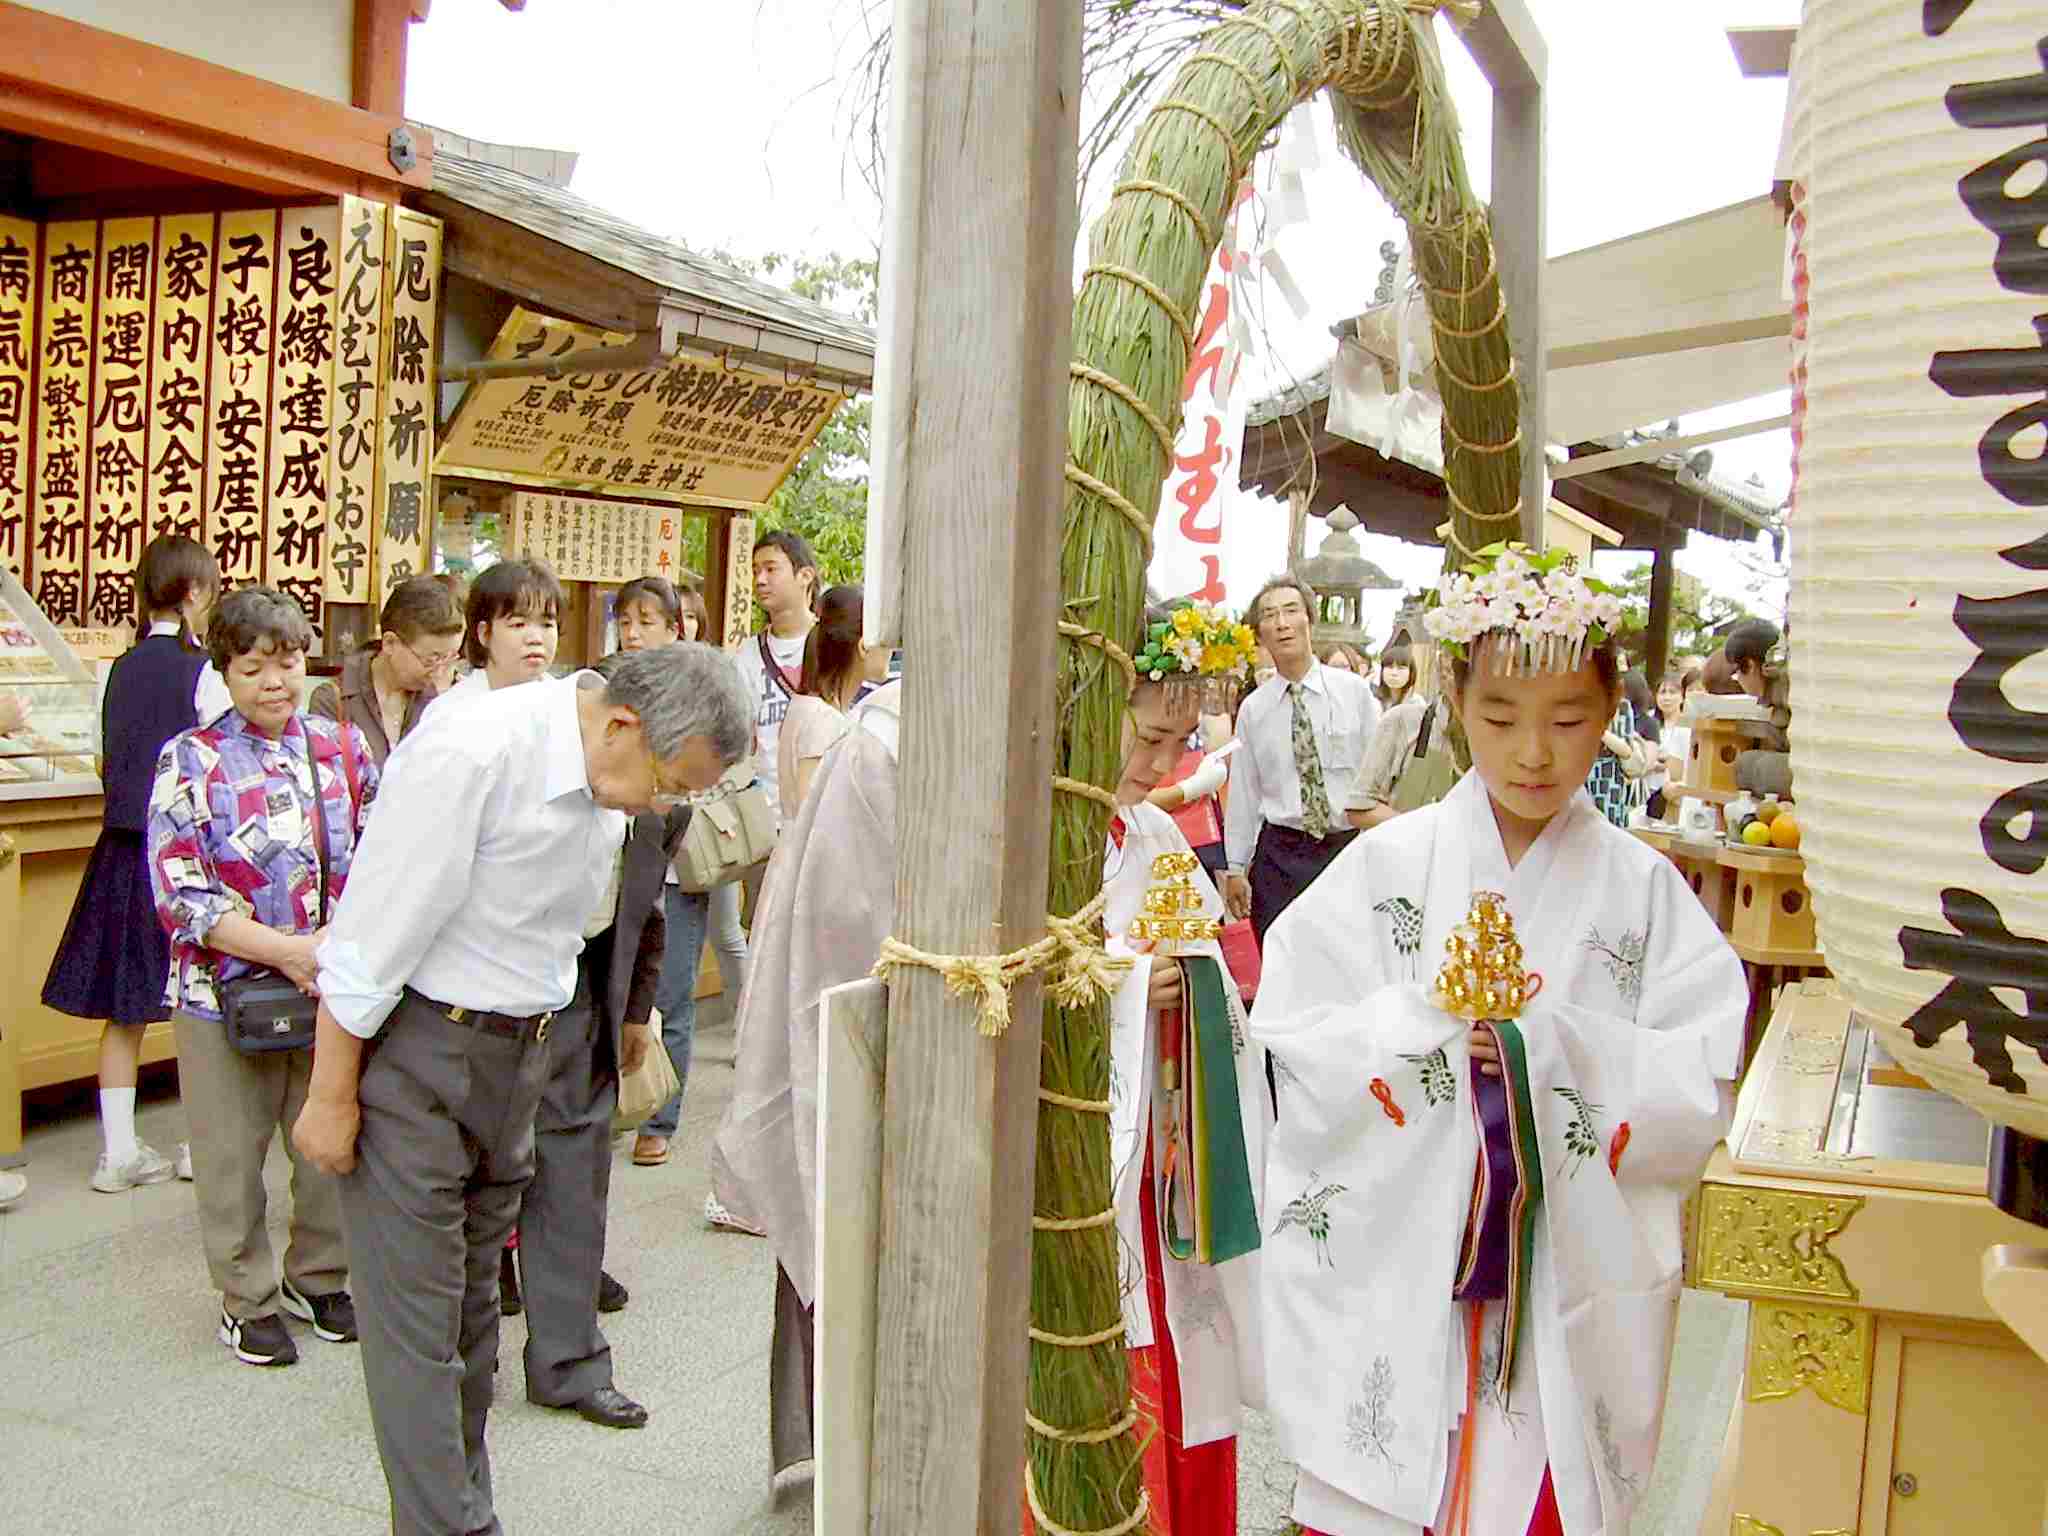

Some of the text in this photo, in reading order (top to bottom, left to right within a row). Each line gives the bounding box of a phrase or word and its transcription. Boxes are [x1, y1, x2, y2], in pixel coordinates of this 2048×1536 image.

[36, 243, 93, 627] 商売繁盛祈願
[88, 241, 151, 629] 開運厄除祈願
[212, 231, 270, 591] 子授け安産祈
[331, 207, 382, 595] えんむすびお守
[513, 384, 635, 424] 厄除祈願
